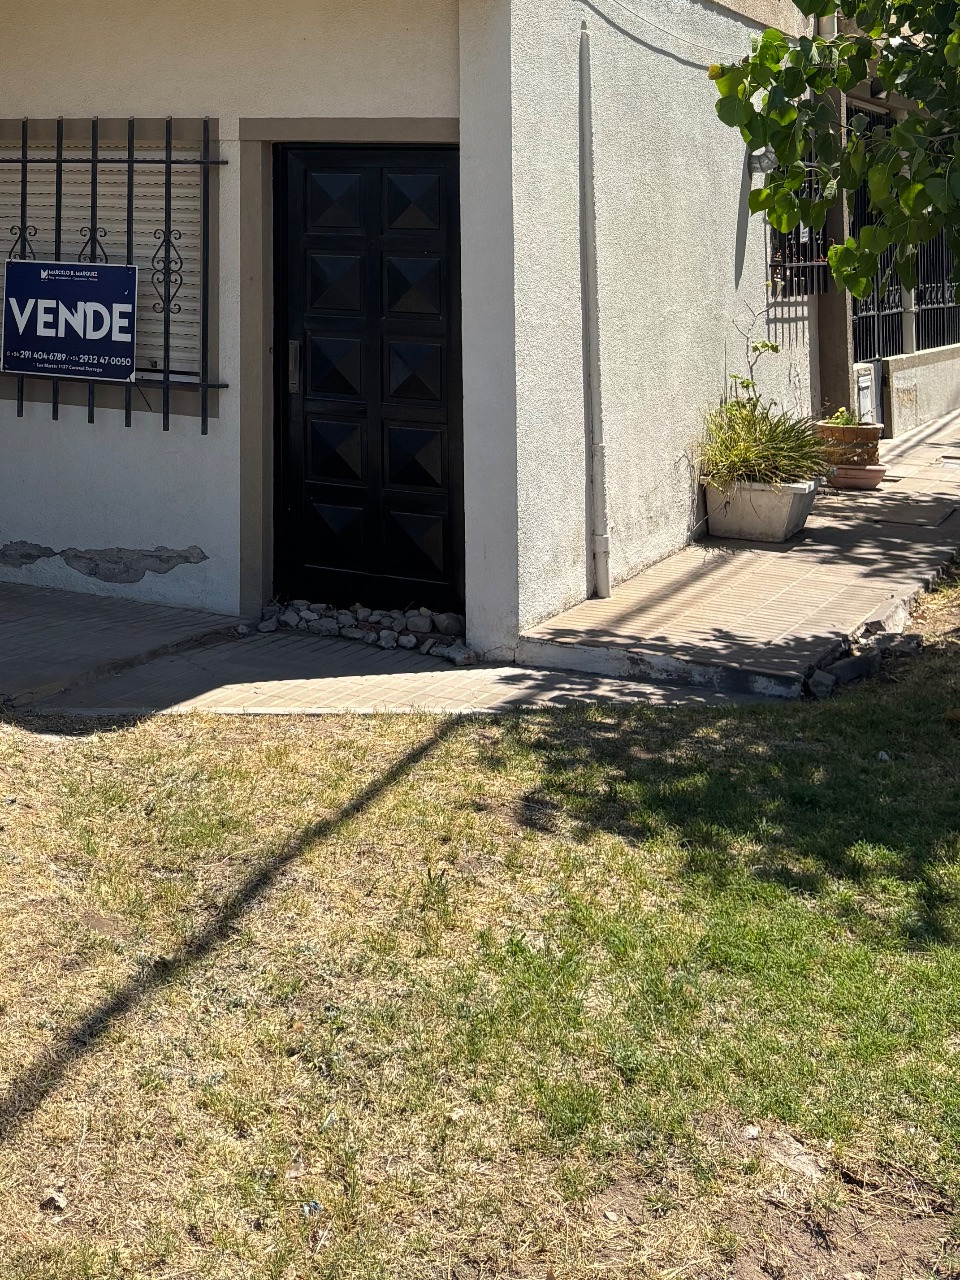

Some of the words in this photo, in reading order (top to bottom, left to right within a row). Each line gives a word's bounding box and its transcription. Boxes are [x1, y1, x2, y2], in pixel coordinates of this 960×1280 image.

[8, 297, 133, 343] VENDE
[19, 350, 32, 359] 291
[33, 351, 67, 361] 404-6789
[78, 354, 98, 364] 2932
[99, 356, 132, 366] 47-0050
